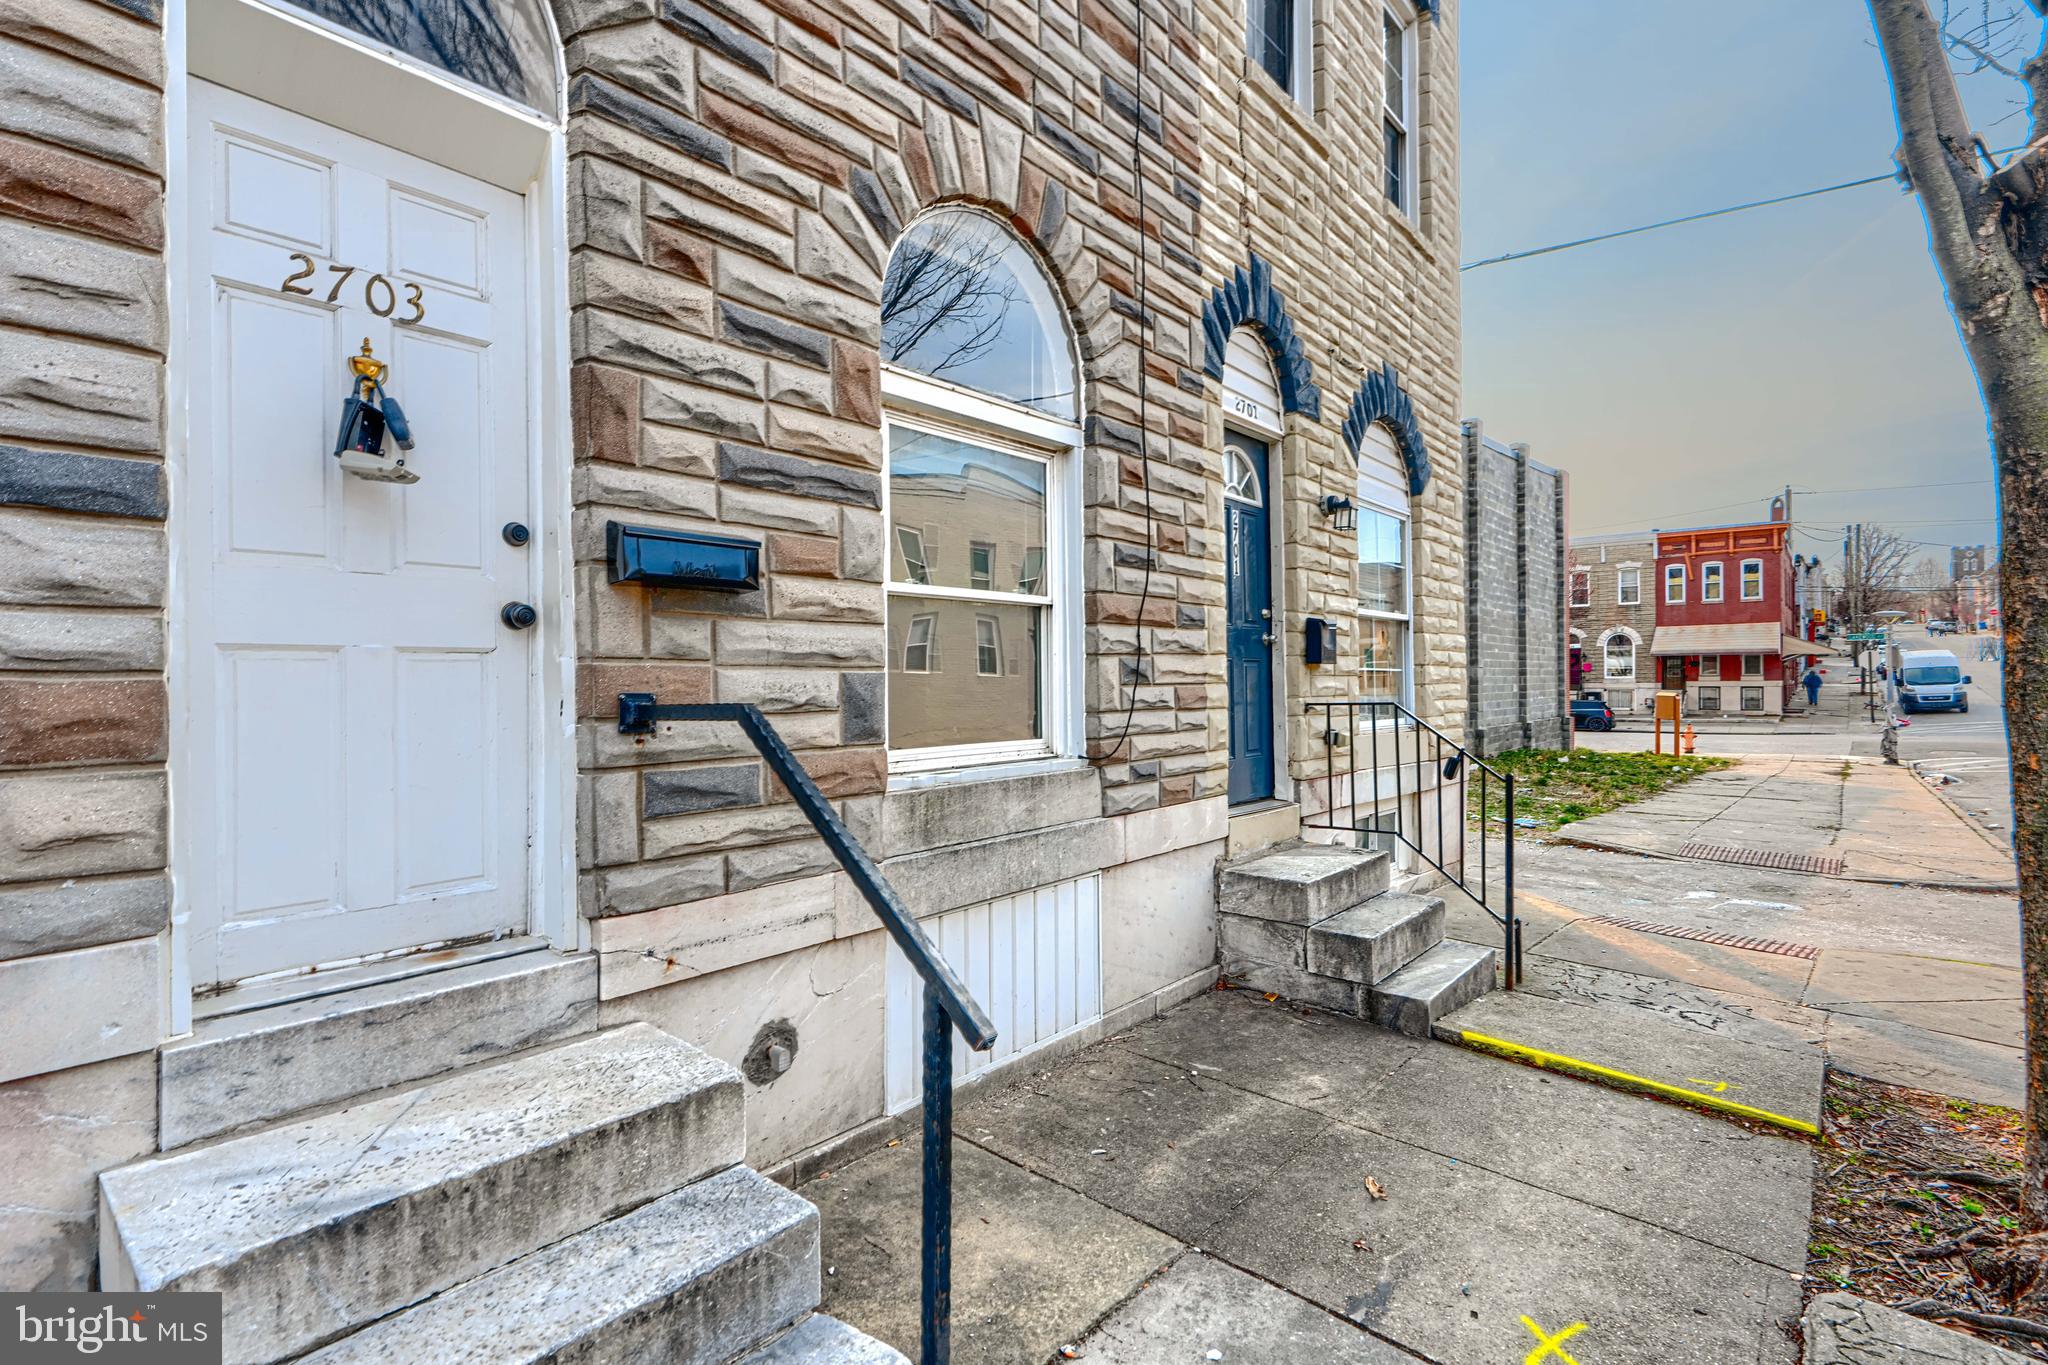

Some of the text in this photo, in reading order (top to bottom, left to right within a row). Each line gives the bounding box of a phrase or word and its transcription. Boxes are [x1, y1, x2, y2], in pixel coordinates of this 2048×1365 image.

[281, 253, 426, 325] 2703
[1235, 396, 1258, 420] 2701
[1231, 510, 1239, 576] 2701
